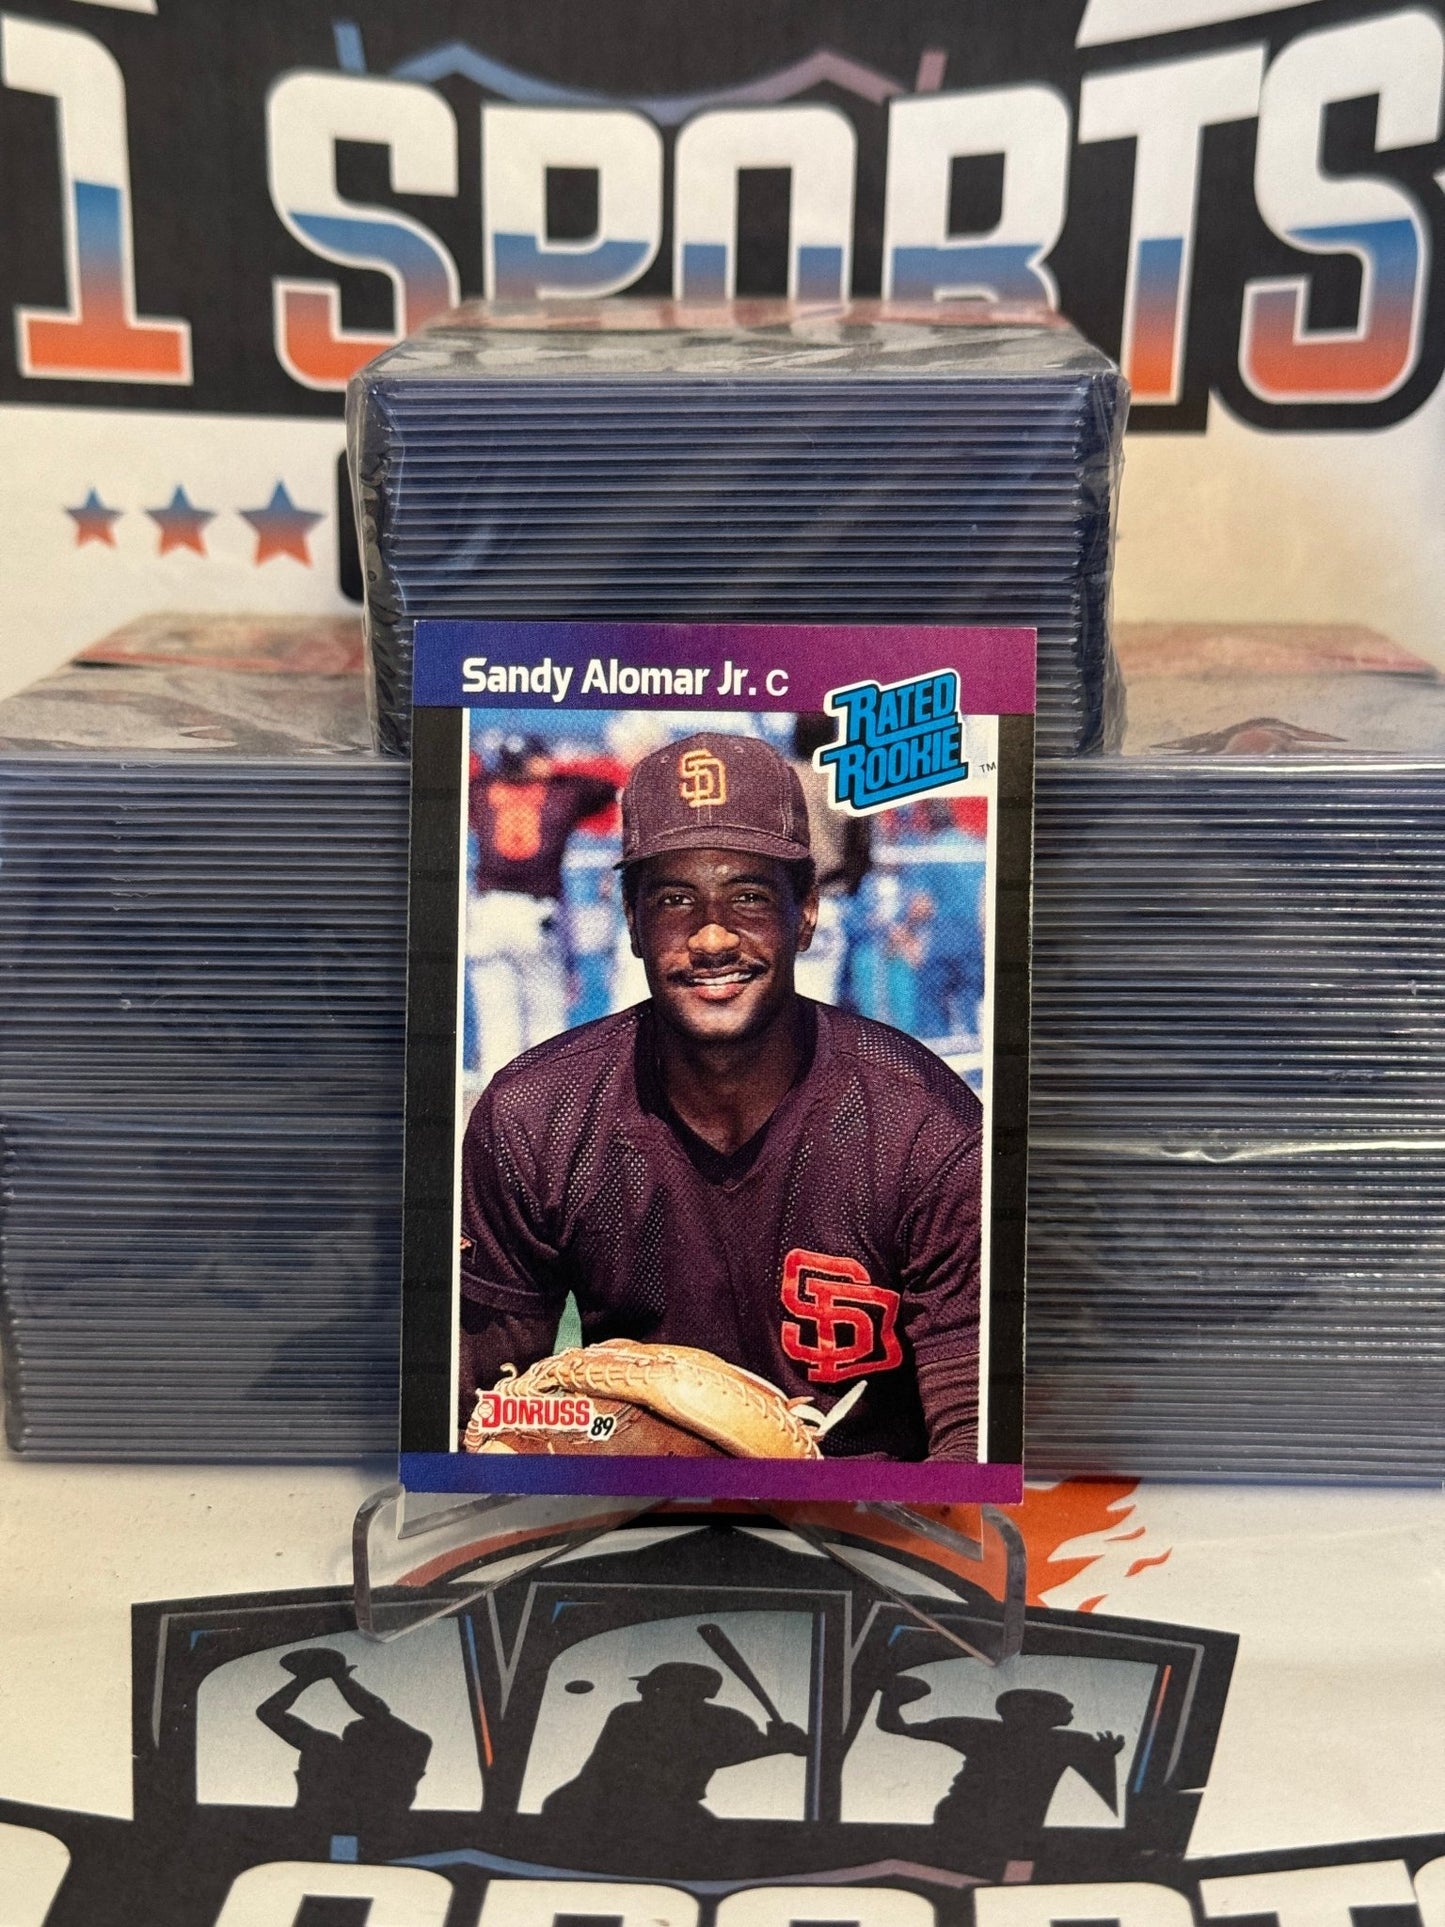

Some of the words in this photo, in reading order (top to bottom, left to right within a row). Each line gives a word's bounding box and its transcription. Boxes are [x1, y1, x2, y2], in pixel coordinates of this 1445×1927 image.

[2, 14, 193, 386] 1
[266, 9, 1443, 405] SPORTS
[462, 657, 574, 703] Sandy
[580, 658, 710, 696] Alomar
[716, 660, 757, 696] Jr.
[832, 671, 957, 748] RATED
[680, 748, 727, 808] SD
[820, 725, 969, 810] ROOKIE
[978, 761, 997, 774] TM
[781, 1248, 903, 1383] SD
[478, 1393, 590, 1429] DONRUSS
[590, 1415, 615, 1437] 89
